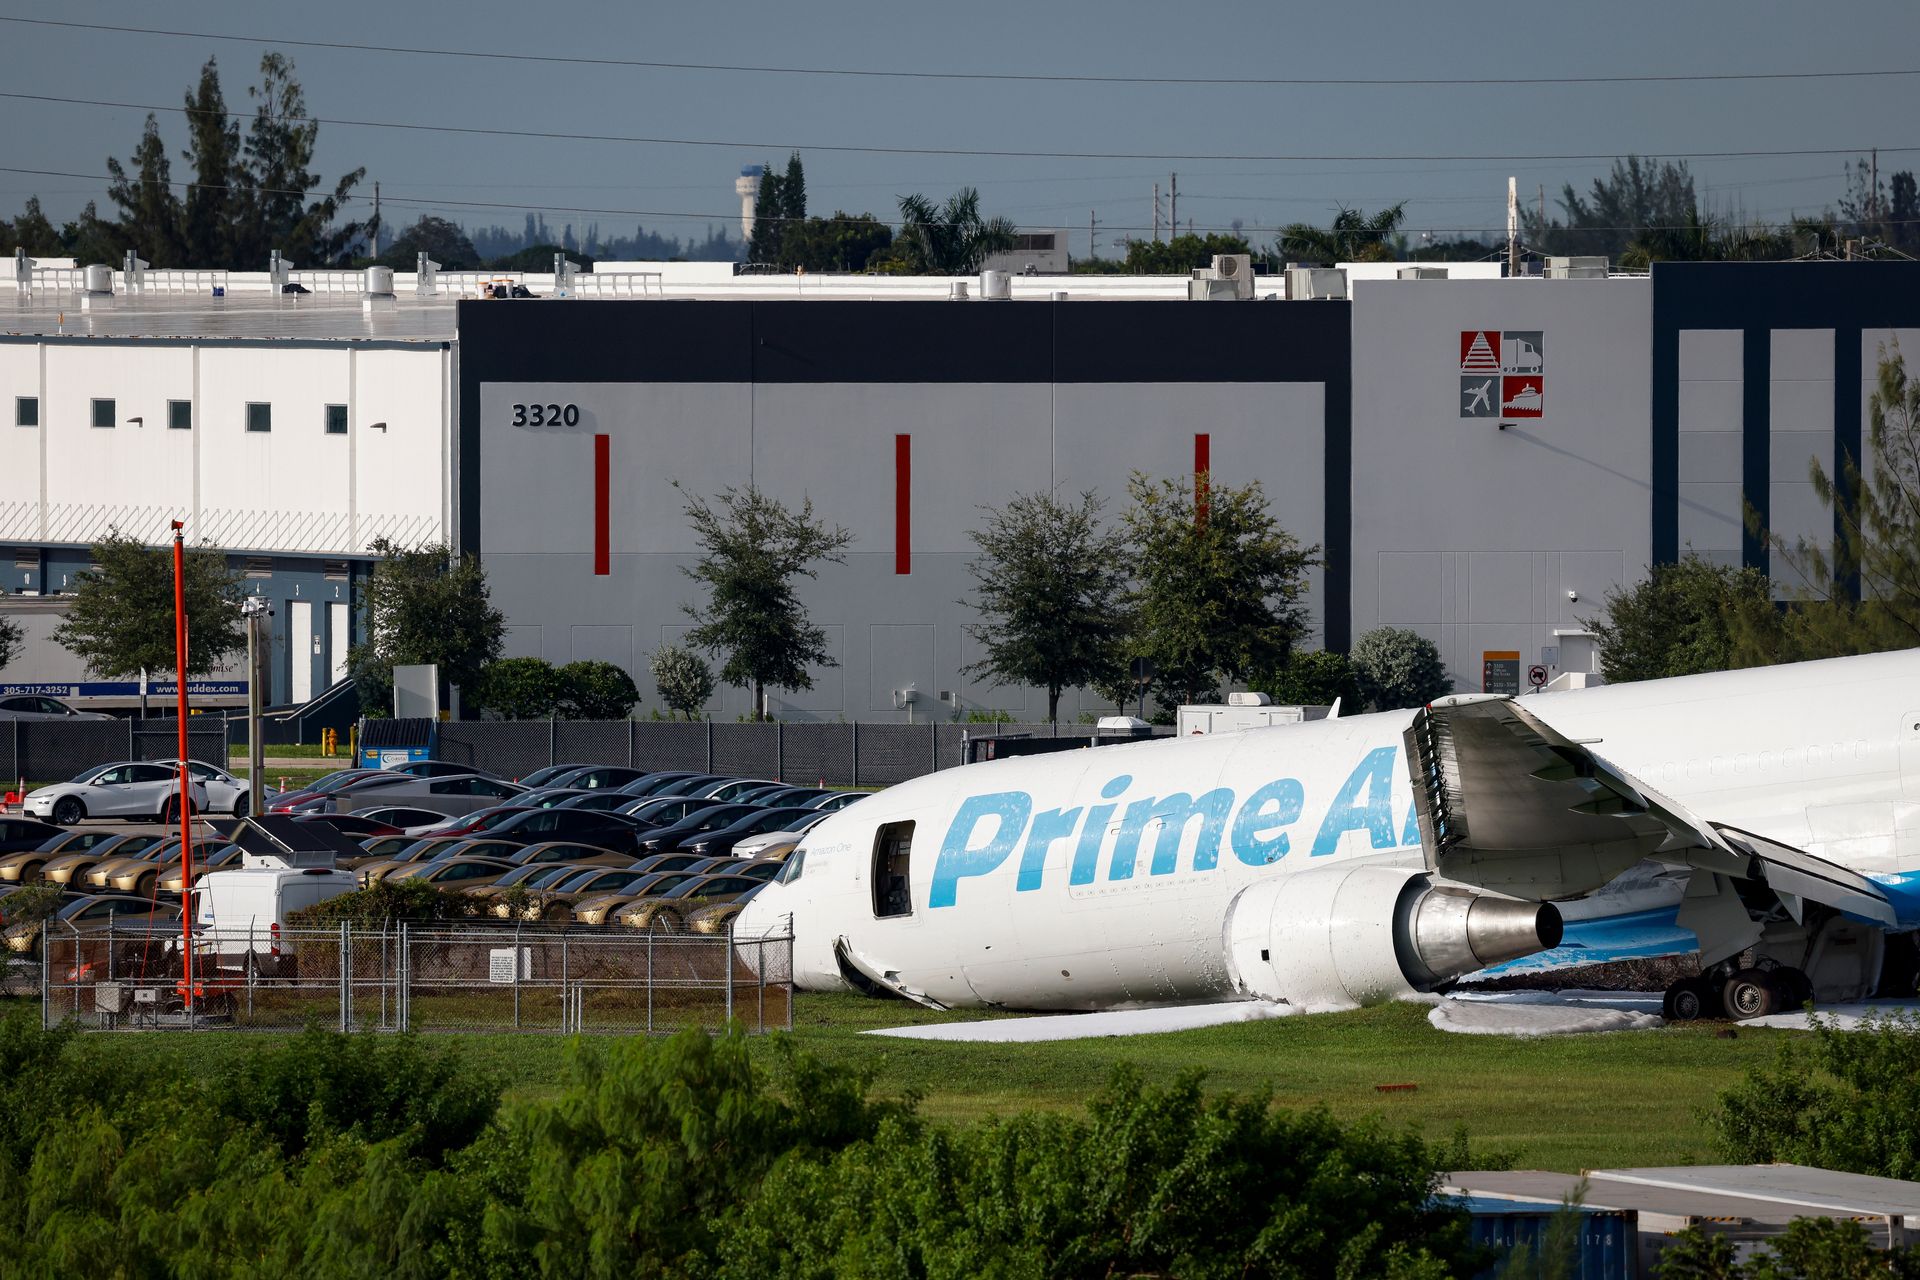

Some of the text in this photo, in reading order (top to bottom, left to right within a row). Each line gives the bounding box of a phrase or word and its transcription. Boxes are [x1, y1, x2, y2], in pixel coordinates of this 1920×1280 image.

[511, 403, 580, 427] 3320
[3, 686, 68, 695] 305-717-3252
[155, 683, 239, 693] wwwuddex.com
[929, 774, 1305, 909] Prime
